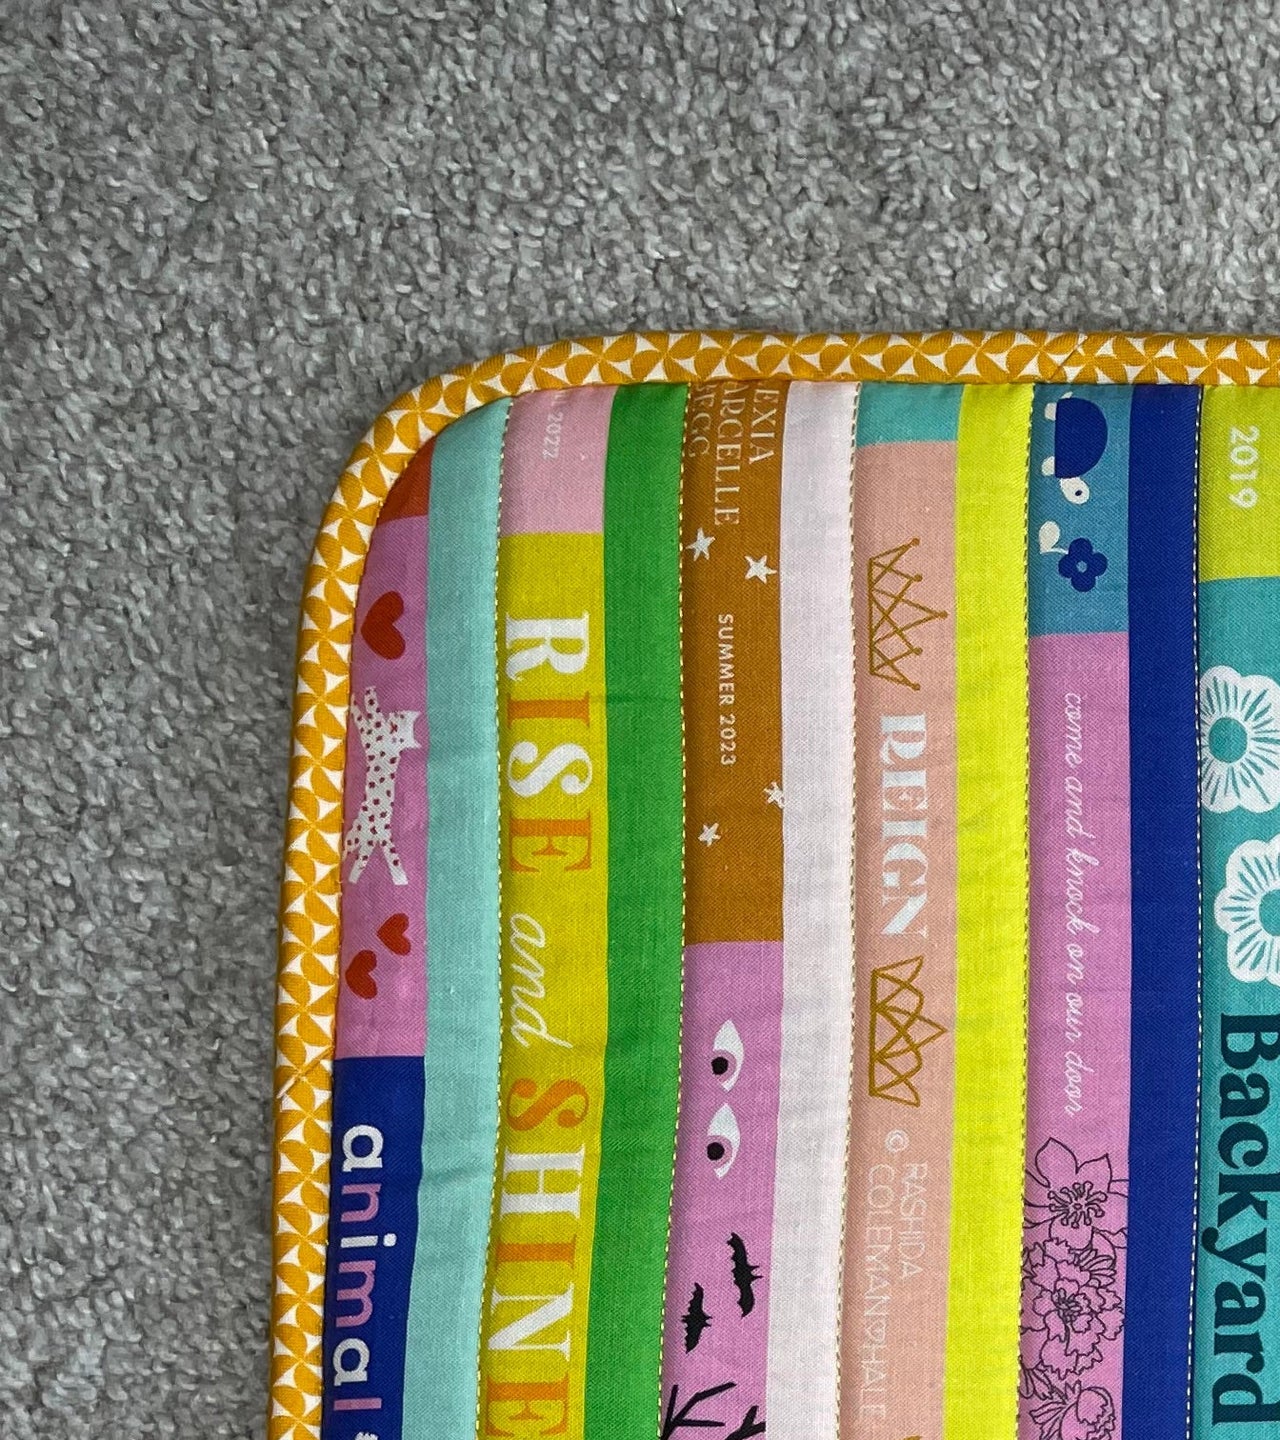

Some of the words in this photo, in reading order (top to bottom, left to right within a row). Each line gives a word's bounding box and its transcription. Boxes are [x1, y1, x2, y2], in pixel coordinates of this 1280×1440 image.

[542, 412, 563, 460] 2022
[748, 382, 781, 464] EXIA
[1229, 426, 1260, 509] 2019
[718, 614, 735, 706] SUMMER
[503, 612, 594, 874] RISE
[719, 714, 736, 766] 2023
[1063, 692, 1090, 769] come
[881, 713, 929, 938] REIGN
[1065, 777, 1096, 840] and
[1066, 848, 1098, 933] knock
[509, 913, 572, 1047] and
[1066, 944, 1088, 985] on
[1063, 993, 1085, 1043] our
[1062, 1051, 1095, 1117] door
[899, 1163, 928, 1279] RASHIDA
[334, 1125, 397, 1411] animal
